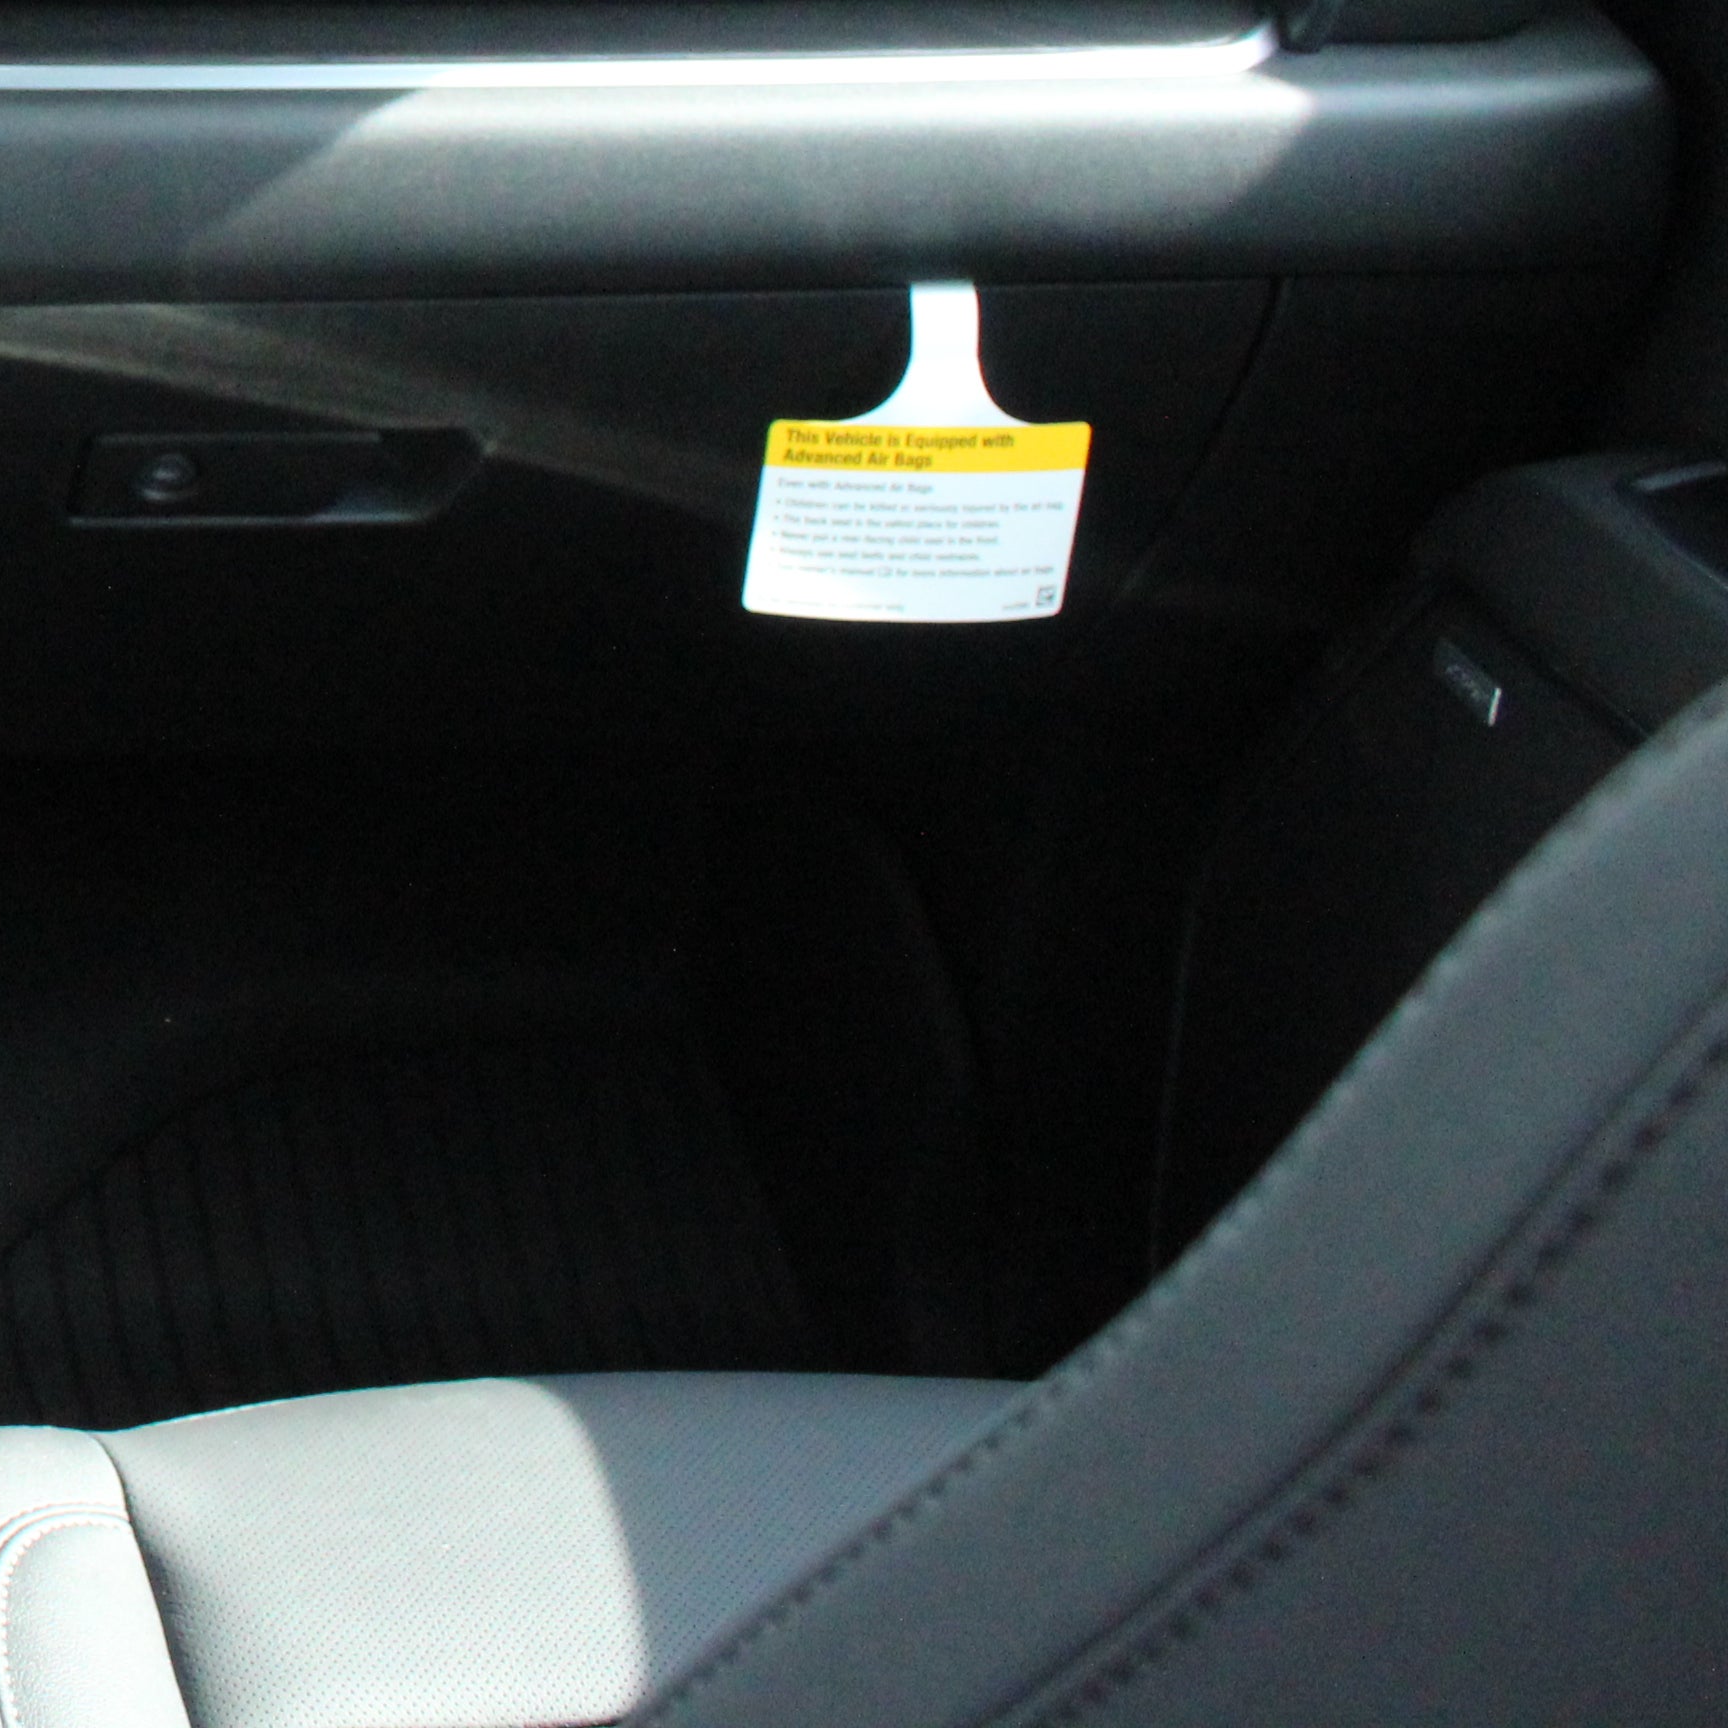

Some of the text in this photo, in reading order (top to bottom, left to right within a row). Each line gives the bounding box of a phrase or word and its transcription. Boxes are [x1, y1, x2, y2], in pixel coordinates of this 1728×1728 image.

[786, 429, 1015, 451] This Vehicle is Equipped with
[784, 448, 933, 471] Advanced Air Bags
